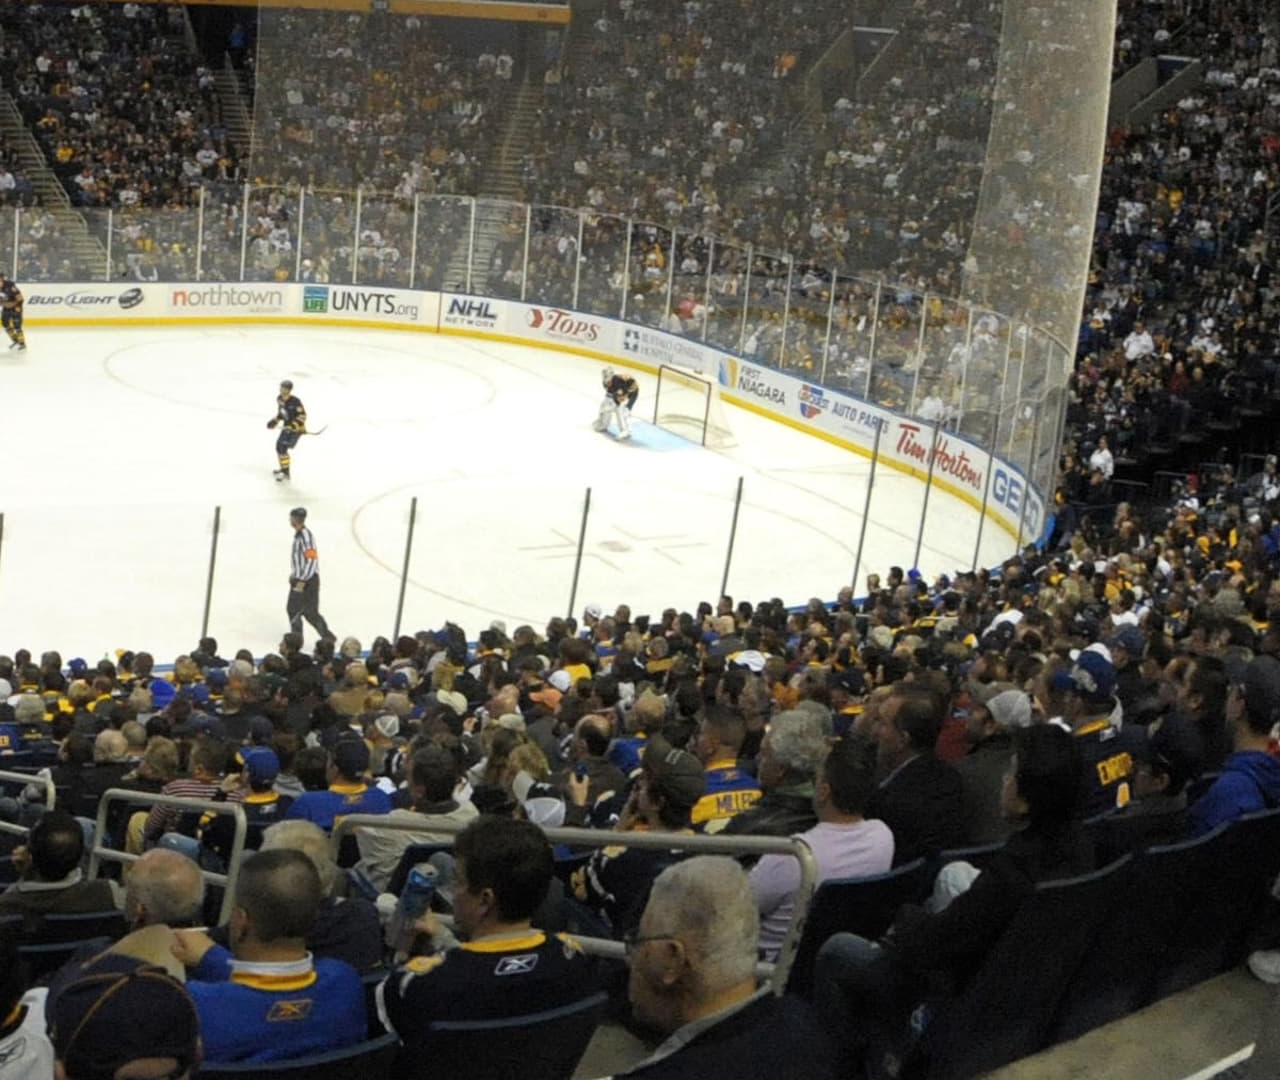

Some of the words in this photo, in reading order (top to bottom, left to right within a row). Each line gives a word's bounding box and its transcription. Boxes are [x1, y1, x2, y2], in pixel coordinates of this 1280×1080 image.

[27, 295, 63, 305] BUD
[71, 294, 116, 306] LIGHT
[171, 284, 283, 308] northtown
[332, 291, 419, 321] UNYTS.org
[448, 297, 497, 320] NHL
[445, 316, 495, 328] NETWORK
[740, 365, 762, 380] FIRST
[738, 377, 786, 406] NIAGARA
[832, 402, 857, 422] AUTO
[896, 423, 926, 463] Tim
[930, 438, 983, 491] Hortons
